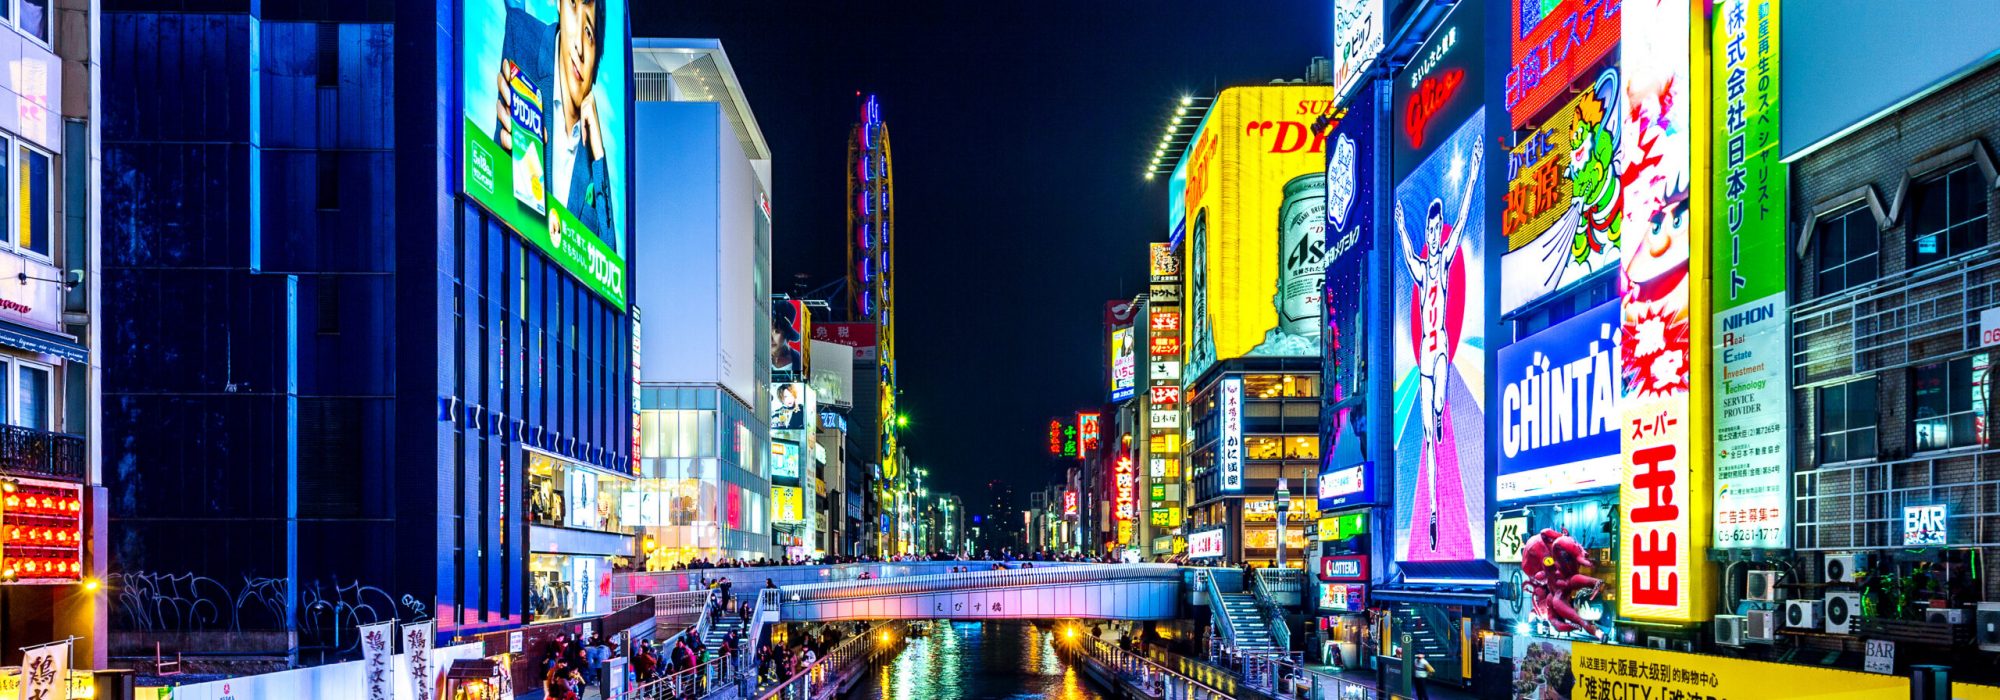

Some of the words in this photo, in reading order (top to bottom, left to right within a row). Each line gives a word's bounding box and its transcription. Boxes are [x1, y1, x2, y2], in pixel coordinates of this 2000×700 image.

[512, 92, 543, 138] サロンパス
[1405, 68, 1464, 149] Glico
[1508, 127, 1555, 181] かぜに
[1727, 0, 1746, 299] 株式会社日本リート
[1502, 155, 1559, 237] 改源
[587, 241, 623, 299] サロンパス
[1428, 280, 1438, 353] グリコ
[1723, 303, 1774, 332] NIHON
[816, 326, 849, 338] 免税
[1723, 332, 1745, 348] Real
[1723, 349, 1752, 364] Estate
[1723, 363, 1765, 380] Investment
[1503, 323, 1621, 459] CHINTAI
[1722, 380, 1767, 395] Technology
[1723, 393, 1755, 408] SERVICE
[1152, 413, 1177, 423] 白木屋
[1723, 403, 1761, 419] PROVIDER
[1632, 411, 1678, 440] スーパー
[1630, 444, 1679, 607] 玉出
[1719, 508, 1779, 524] 広告主募集中
[1904, 506, 1946, 533] BAR
[1332, 561, 1358, 574] LOTTERIA
[936, 602, 1002, 613] えびす橋
[1866, 641, 1894, 659] BAR
[408, 629, 430, 700] 鶏水炊き
